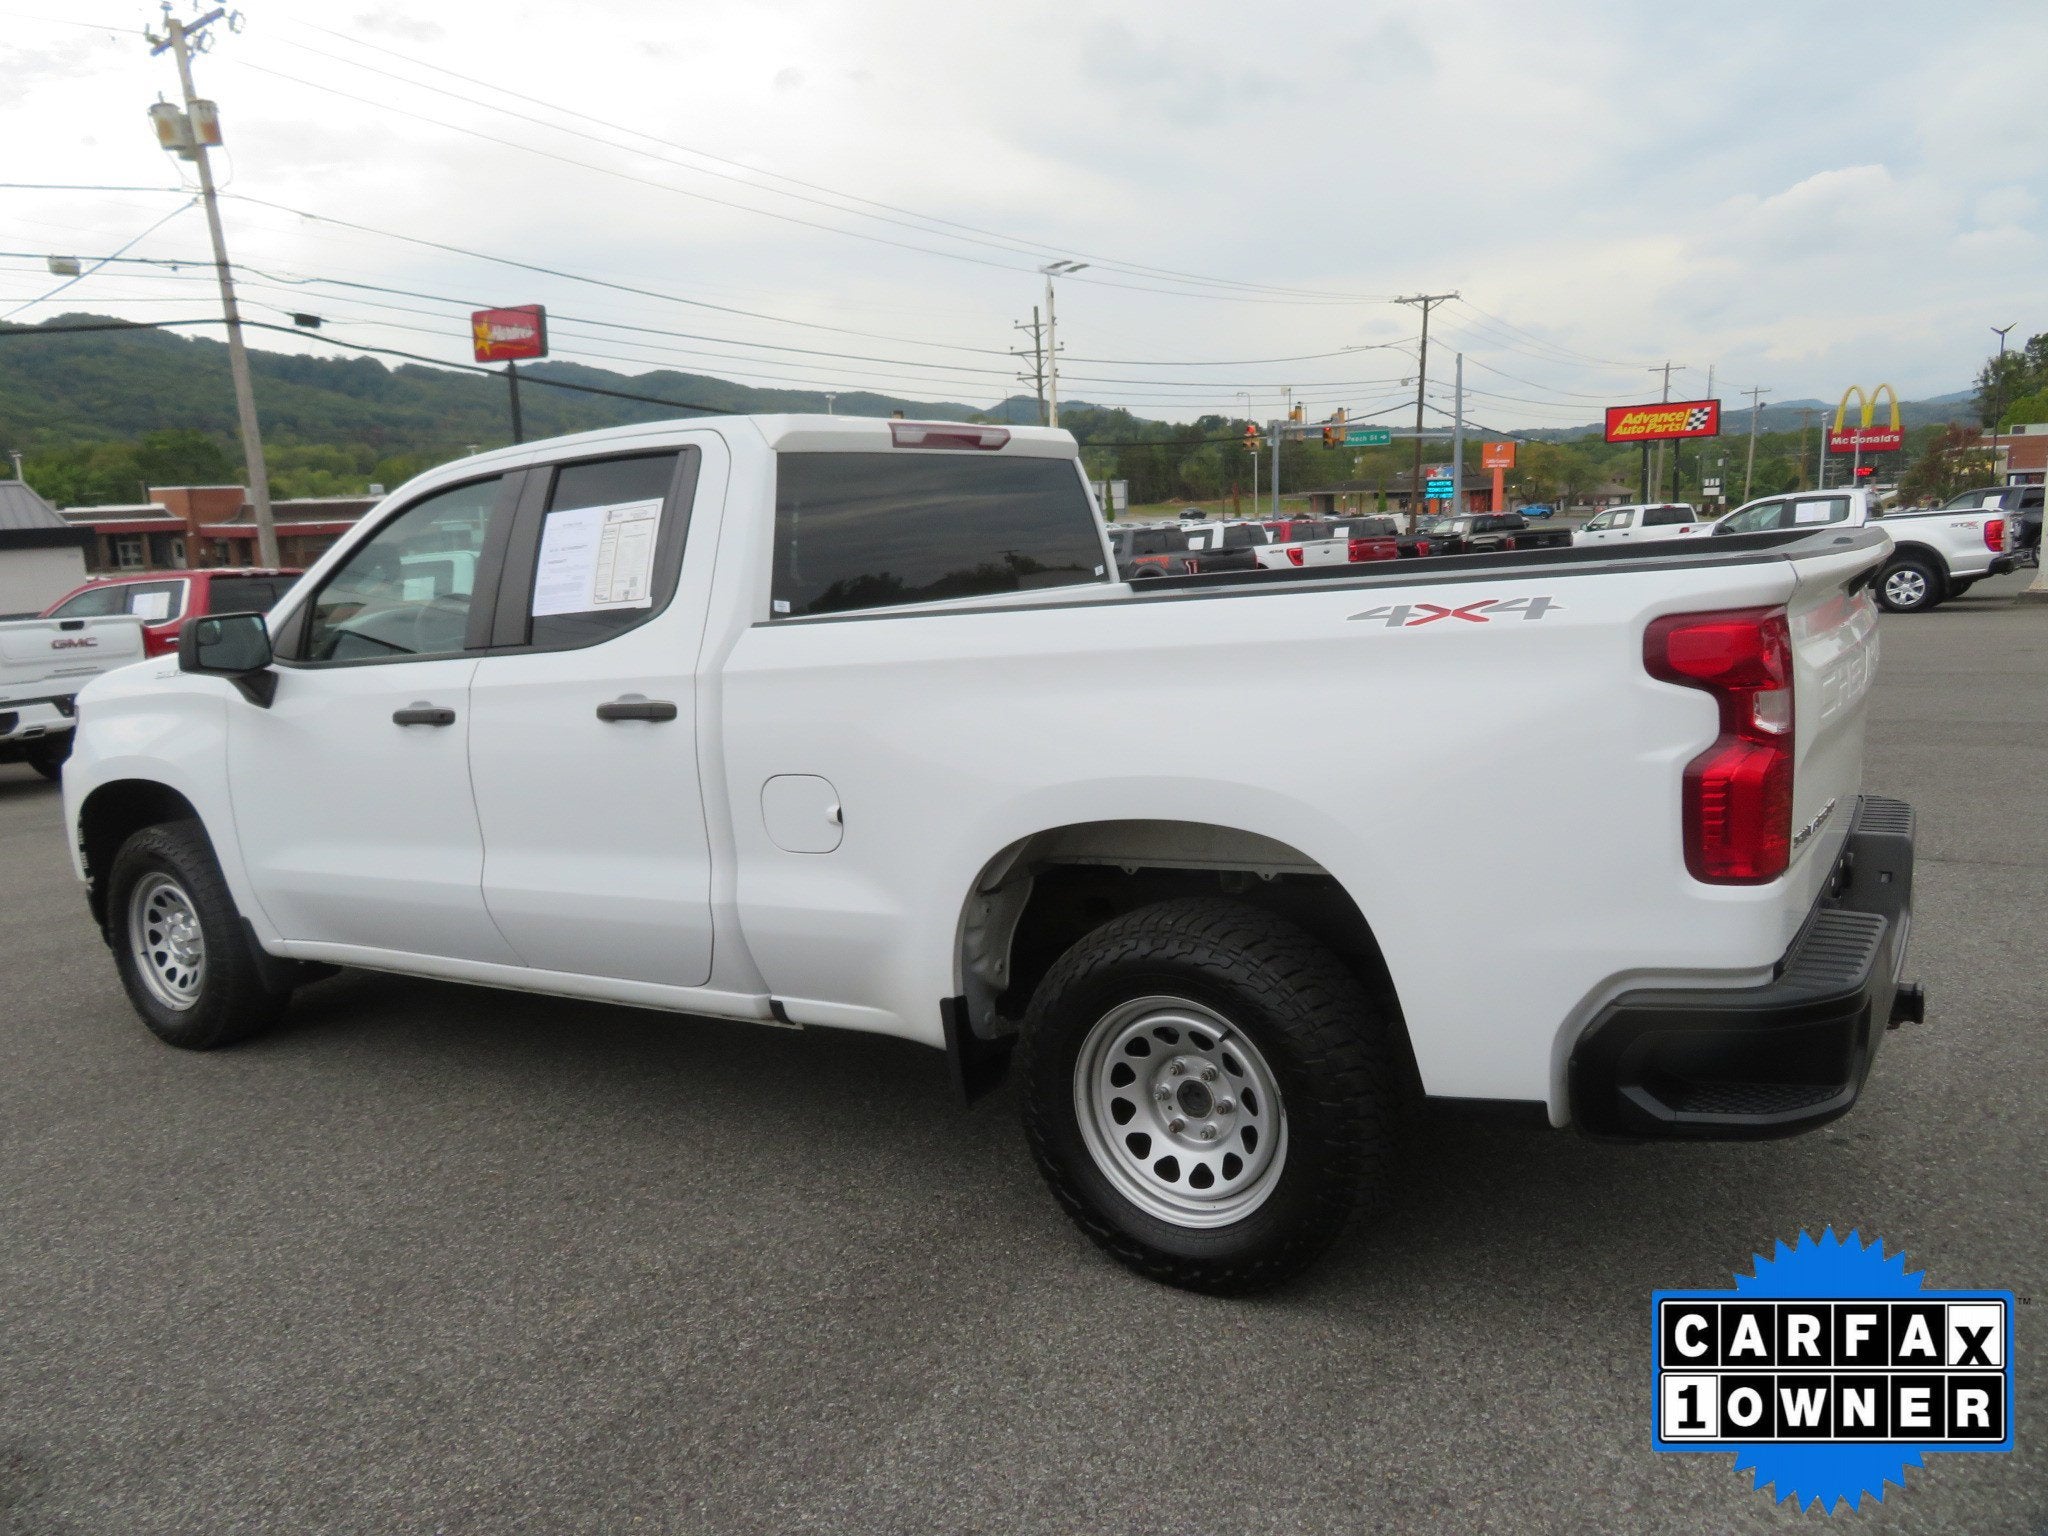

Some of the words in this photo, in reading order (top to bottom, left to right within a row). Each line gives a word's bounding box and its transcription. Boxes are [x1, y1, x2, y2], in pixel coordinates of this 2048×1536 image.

[1622, 411, 1685, 424] Advance
[1612, 424, 1645, 435] Auto
[1645, 421, 1682, 433] Parts
[1831, 434, 1900, 446] McDonald's
[51, 637, 98, 649] GMC
